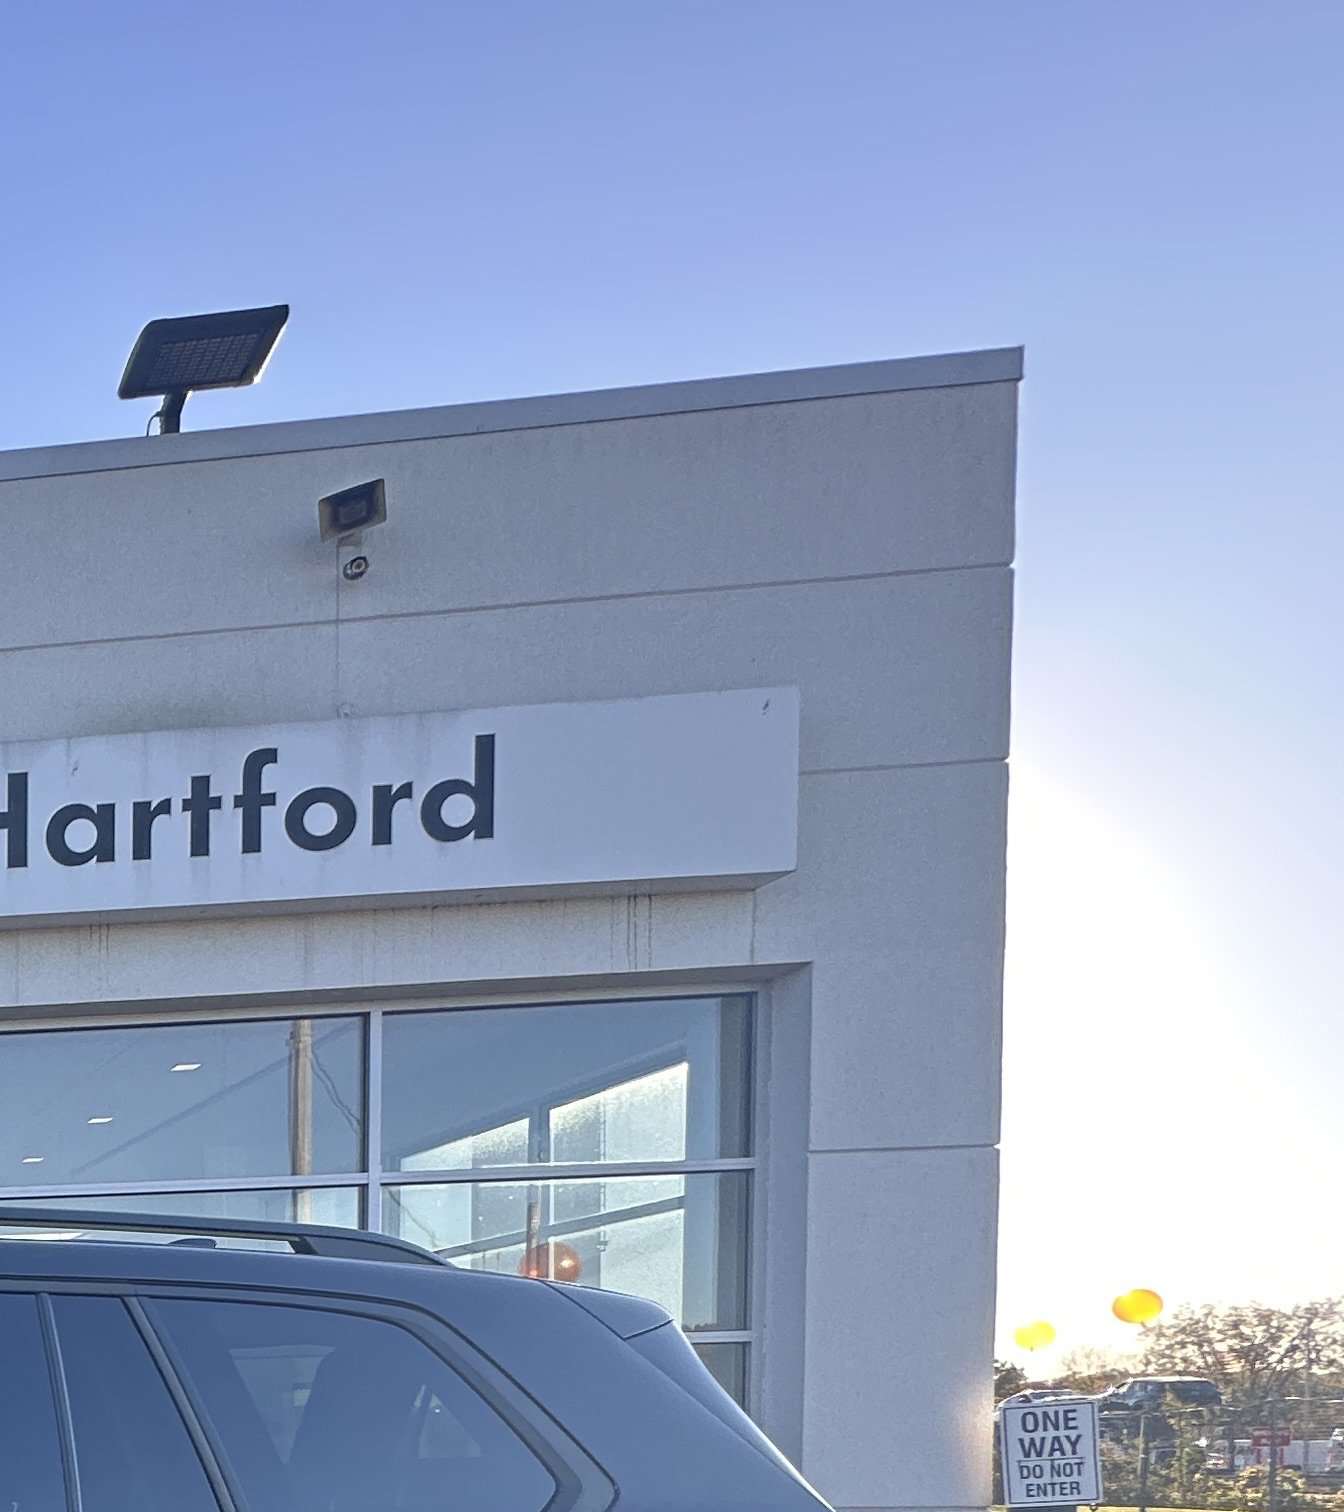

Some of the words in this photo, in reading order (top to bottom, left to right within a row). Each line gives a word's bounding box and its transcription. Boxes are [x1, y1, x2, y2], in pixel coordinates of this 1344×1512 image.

[1020, 1409, 1078, 1433] ONE
[1017, 1434, 1082, 1458] WAY
[1019, 1464, 1044, 1480] DO
[1050, 1462, 1084, 1479] NOT
[1025, 1481, 1081, 1497] ENTER
